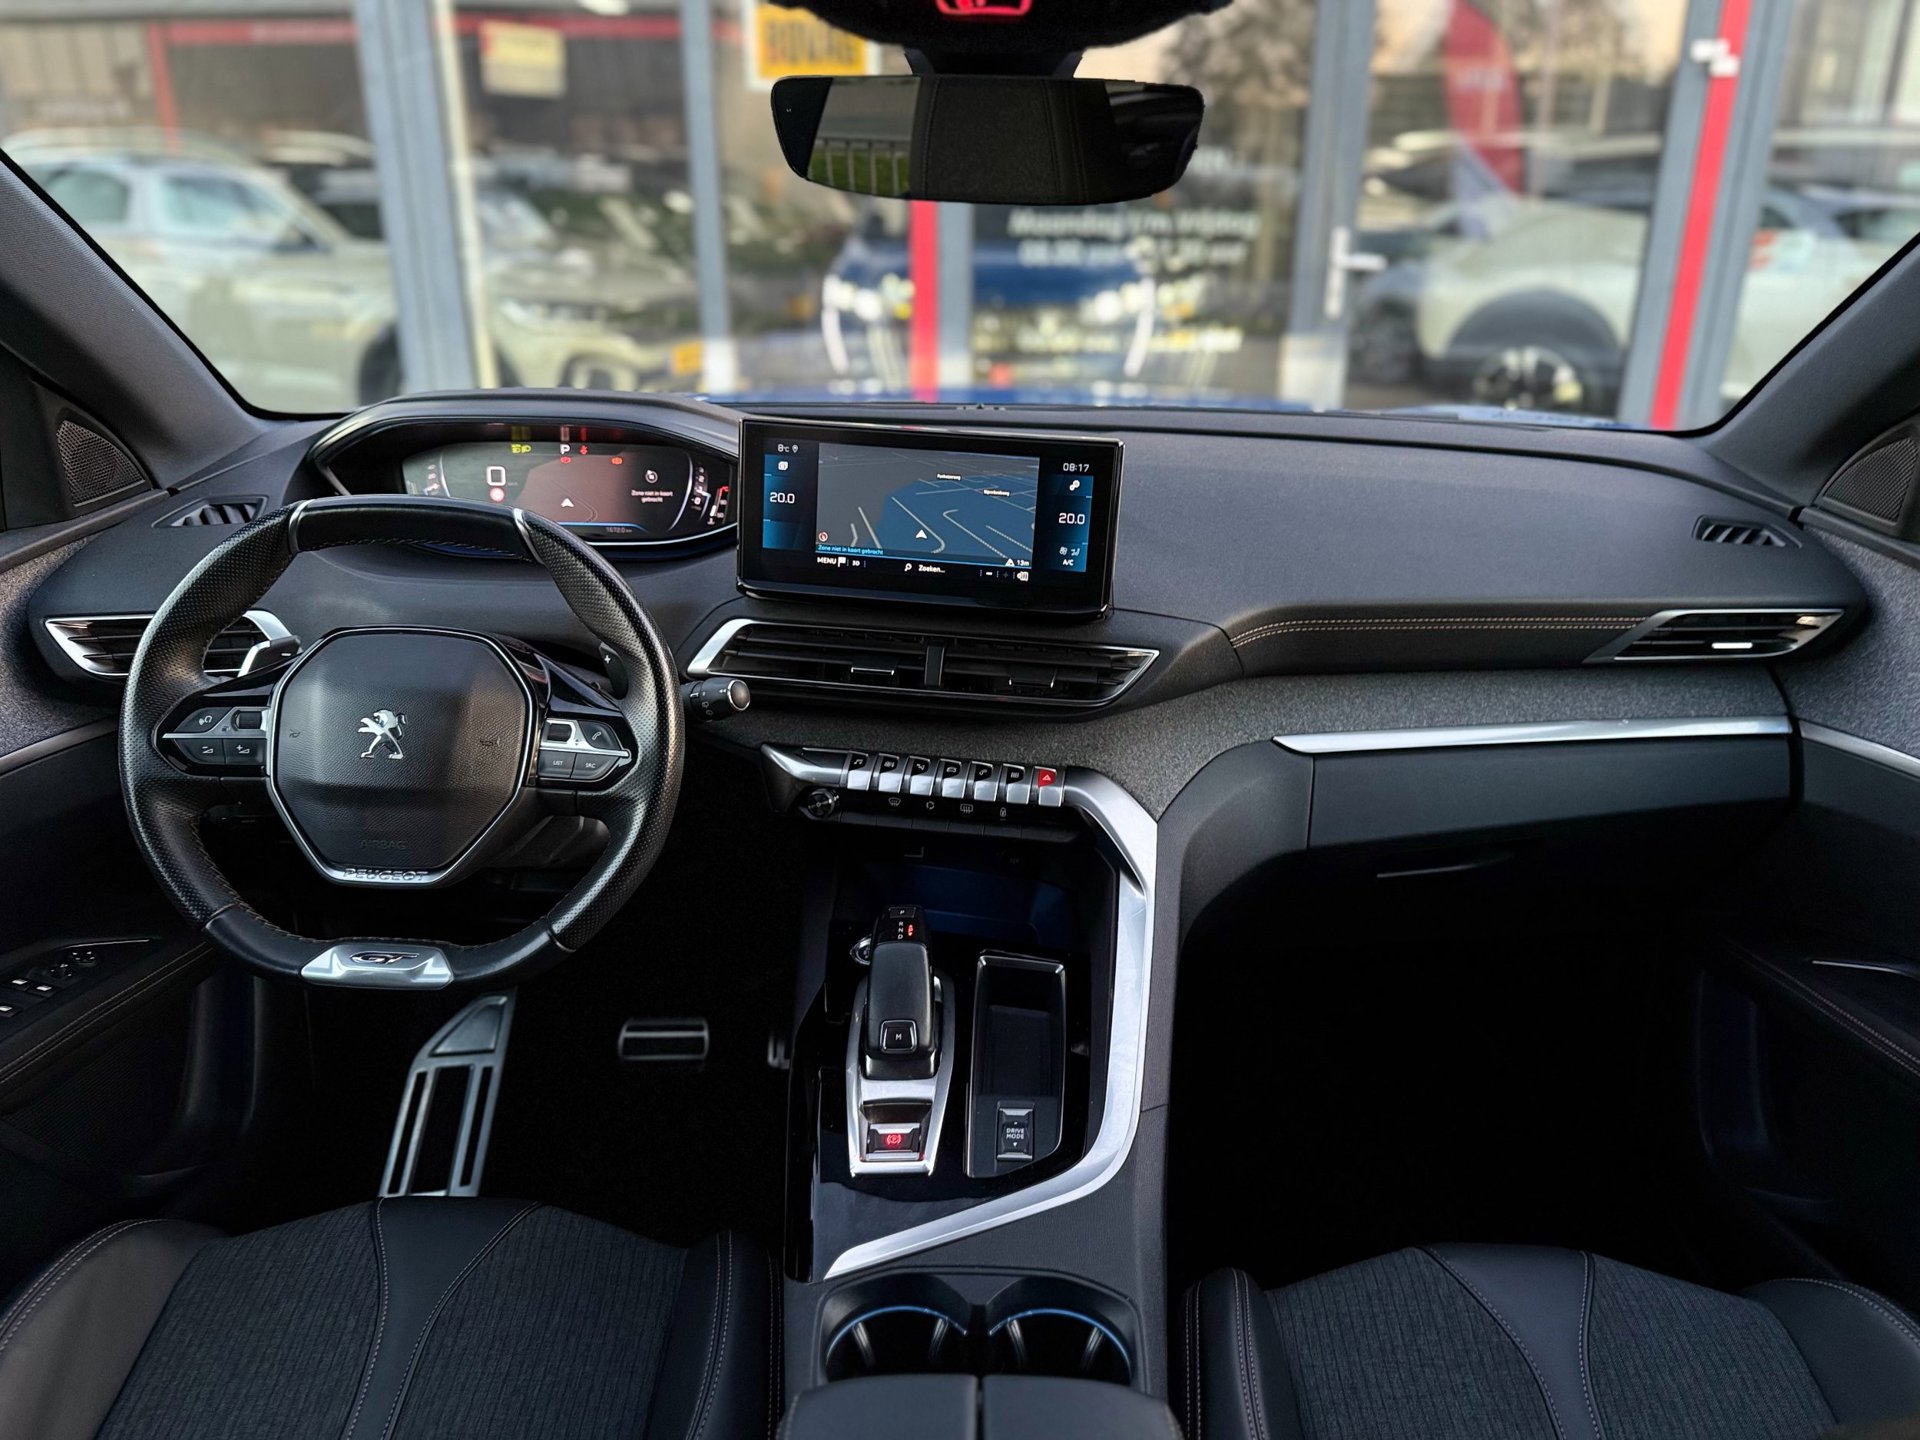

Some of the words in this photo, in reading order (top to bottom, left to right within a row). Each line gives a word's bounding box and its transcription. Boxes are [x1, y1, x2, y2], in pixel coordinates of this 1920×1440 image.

[560, 444, 570, 455] P
[1062, 463, 1090, 472] 08:17
[486, 466, 506, 486] 0
[769, 492, 796, 504] 20.0
[1058, 513, 1086, 525] 20.0
[817, 557, 837, 565] MENU
[343, 867, 429, 881] PEUGEOT
[350, 950, 420, 965] GT
[895, 1033, 903, 1041] M
